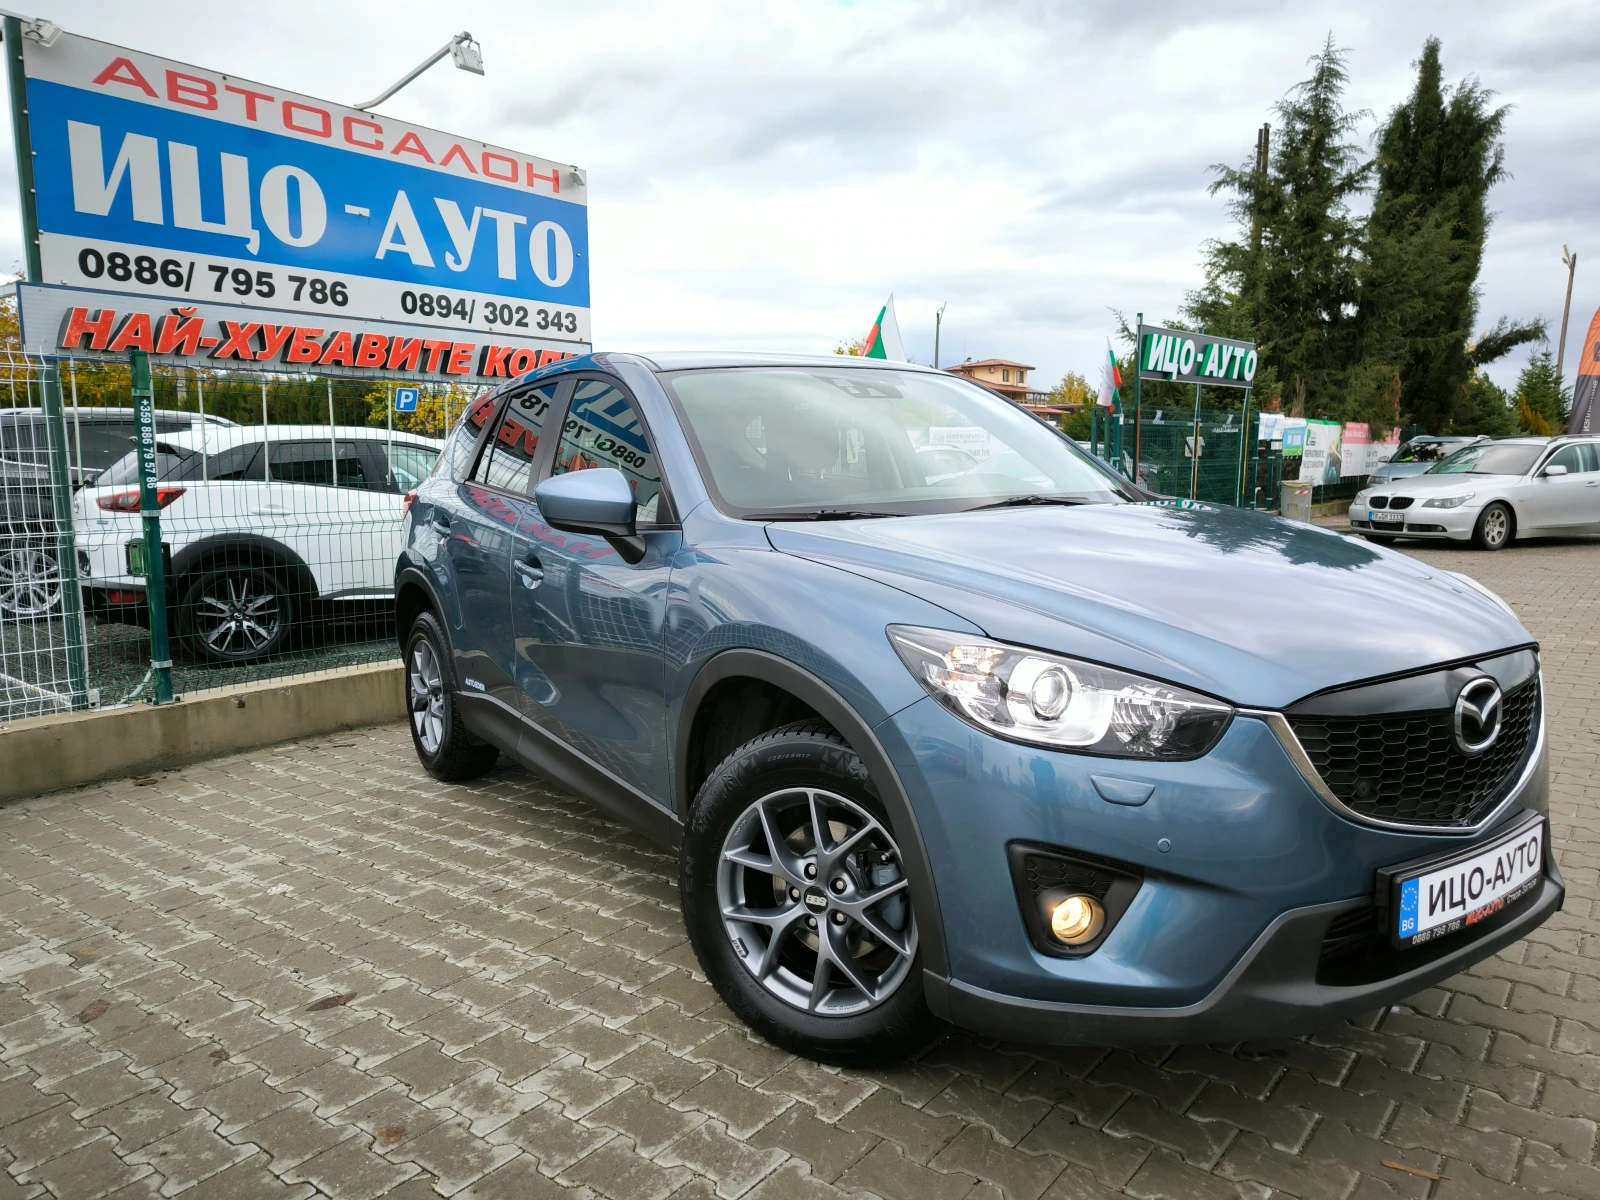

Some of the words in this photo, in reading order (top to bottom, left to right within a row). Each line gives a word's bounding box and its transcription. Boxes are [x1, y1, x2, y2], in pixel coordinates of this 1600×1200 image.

[93, 57, 560, 193] АВТОСАЛОН
[78, 248, 195, 292] 0886/
[208, 264, 275, 299] 795
[288, 274, 349, 307] 786
[401, 291, 476, 324] 0894/
[483, 301, 529, 328] 302
[536, 308, 577, 334] 343
[61, 306, 476, 375] НАЙ-ХУБАВИТЕ
[1147, 333, 1258, 381] ИЦО-АУТО
[399, 390, 414, 409] P
[140, 399, 151, 424] +359
[141, 426, 153, 444] 886
[143, 446, 154, 459] 79
[144, 461, 155, 474] 57
[145, 476, 157, 489] 86
[1428, 835, 1539, 917] ИЦО-АУТО
[805, 894, 827, 907] BBS
[1401, 917, 1415, 932] BG
[1432, 924, 1446, 938] 795
[1447, 920, 1461, 932] 786
